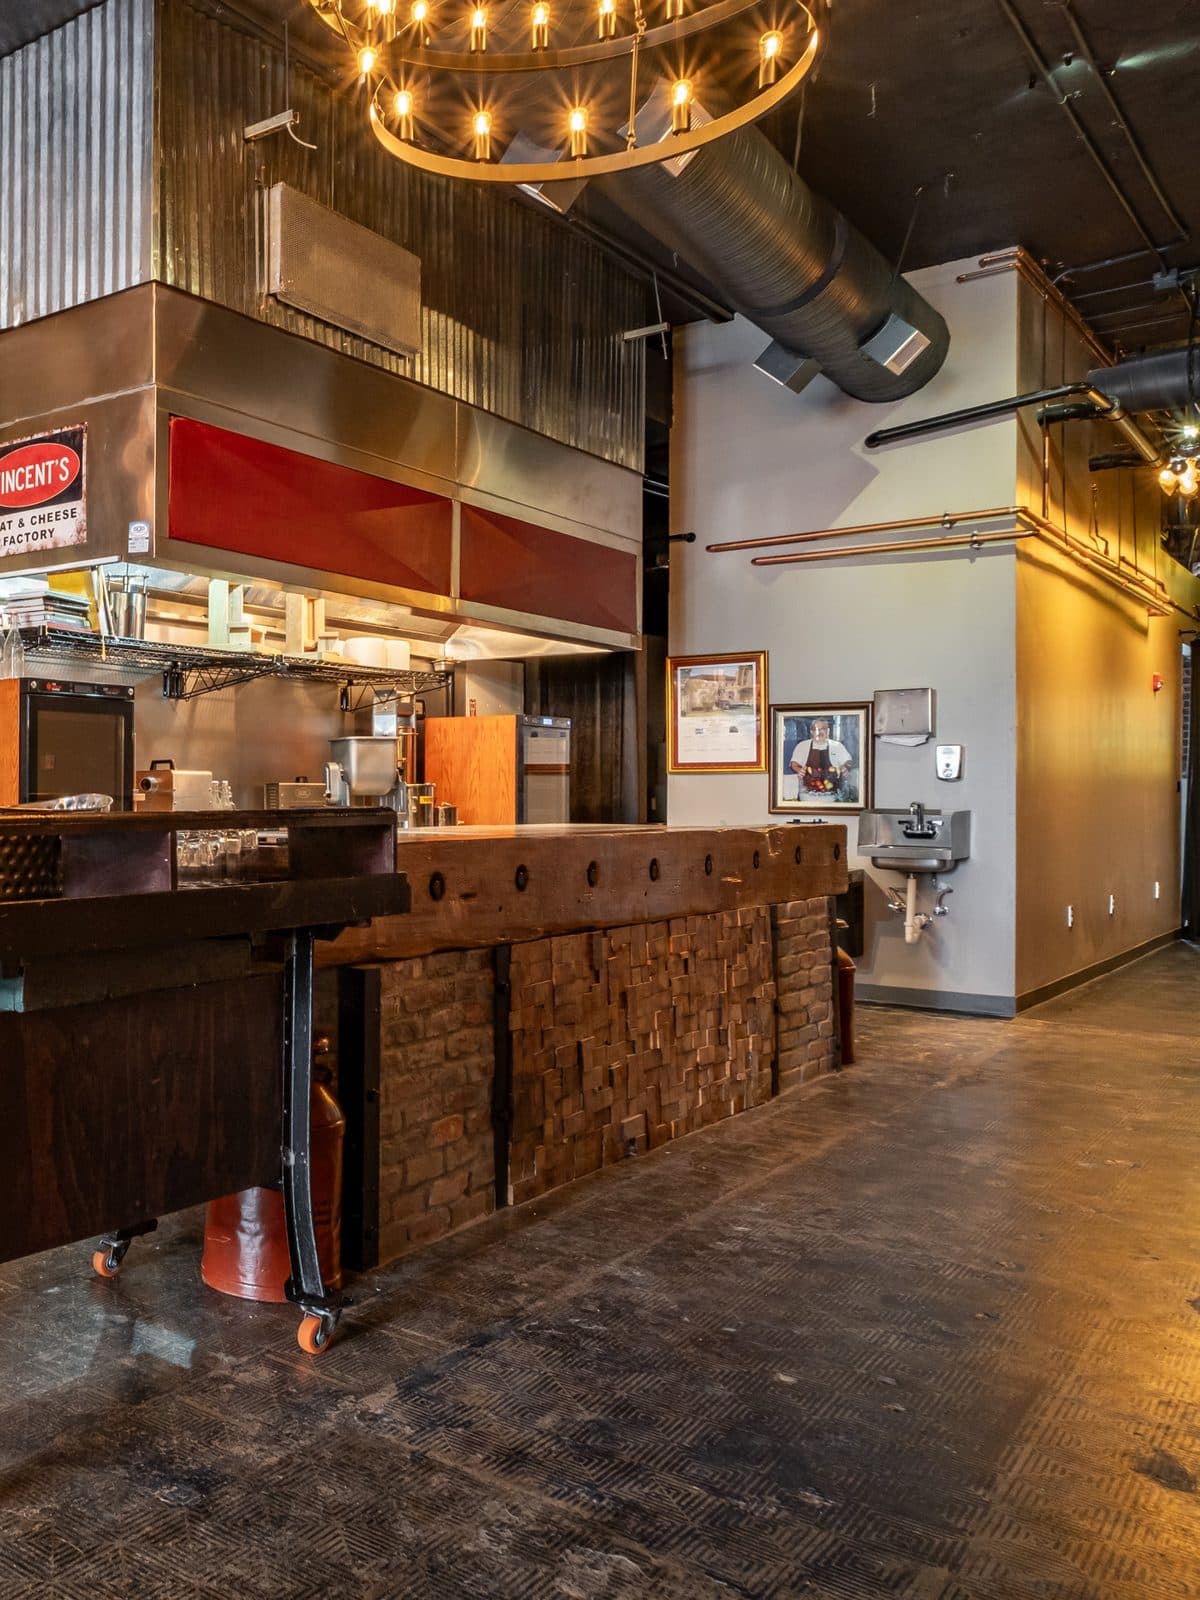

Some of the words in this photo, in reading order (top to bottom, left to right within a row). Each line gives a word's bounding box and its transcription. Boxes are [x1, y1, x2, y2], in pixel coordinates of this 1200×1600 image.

[18, 518, 25, 529] &
[30, 508, 77, 526] CHEESE
[3, 528, 55, 546] FACTORY
